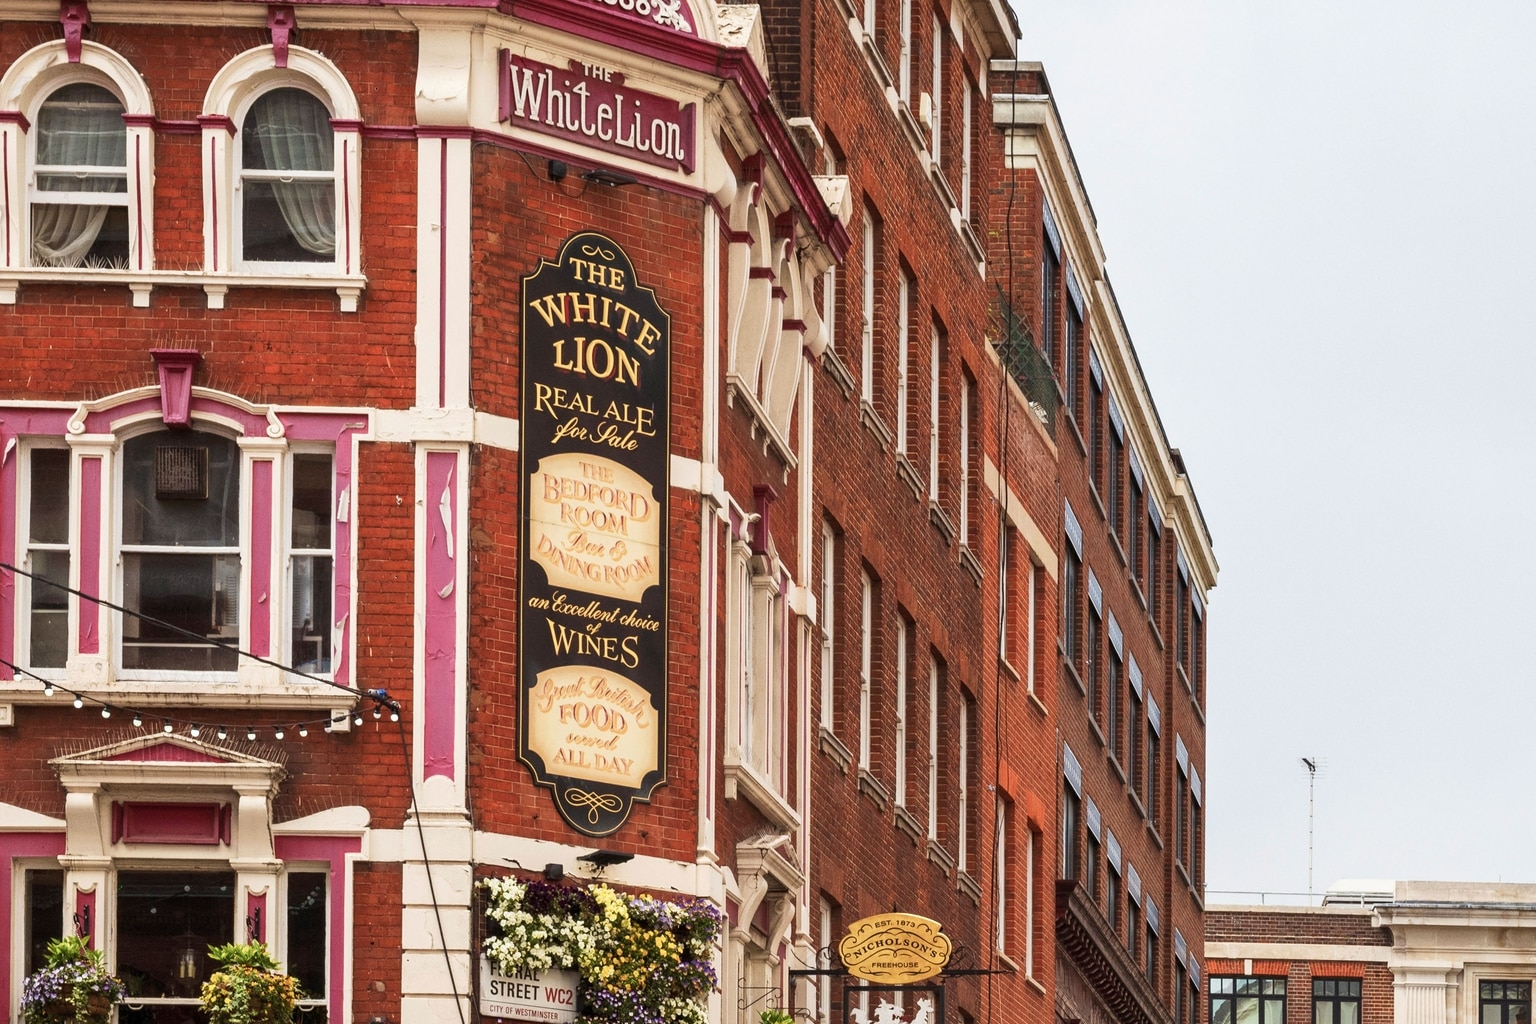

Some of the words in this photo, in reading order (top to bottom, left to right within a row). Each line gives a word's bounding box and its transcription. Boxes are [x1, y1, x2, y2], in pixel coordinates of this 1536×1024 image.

[583, 62, 612, 82] THE
[569, 257, 625, 291] THE
[529, 292, 662, 356] WHITE
[553, 337, 640, 387] LION
[534, 382, 599, 420] REAL
[603, 400, 656, 437] ALE
[551, 416, 588, 444] for
[589, 421, 639, 451] Sale
[579, 461, 615, 484] THE
[543, 473, 650, 522] BEDFORD
[560, 502, 629, 537] ROOM
[561, 530, 606, 558] Bar
[537, 532, 602, 583] DINING
[604, 555, 654, 591] ROOM
[528, 596, 549, 609] an
[551, 590, 621, 624] Excellent
[619, 609, 660, 632] choice
[545, 617, 639, 669] WINES
[586, 622, 602, 635] of
[535, 676, 586, 714] Great
[583, 675, 650, 729] British
[559, 701, 629, 735] FOOD
[566, 732, 620, 751] served
[552, 747, 591, 769] ALL
[594, 753, 634, 777] DAY
[875, 920, 893, 928] EST.
[896, 920, 916, 928] 1873
[853, 938, 938, 959] NICHOLSON'S
[490, 980, 540, 1001] STREET
[545, 986, 574, 1005] WC2
[489, 1005, 504, 1013] CITY
[506, 1007, 513, 1015] OF
[514, 1008, 559, 1020] WESTMINSTER
